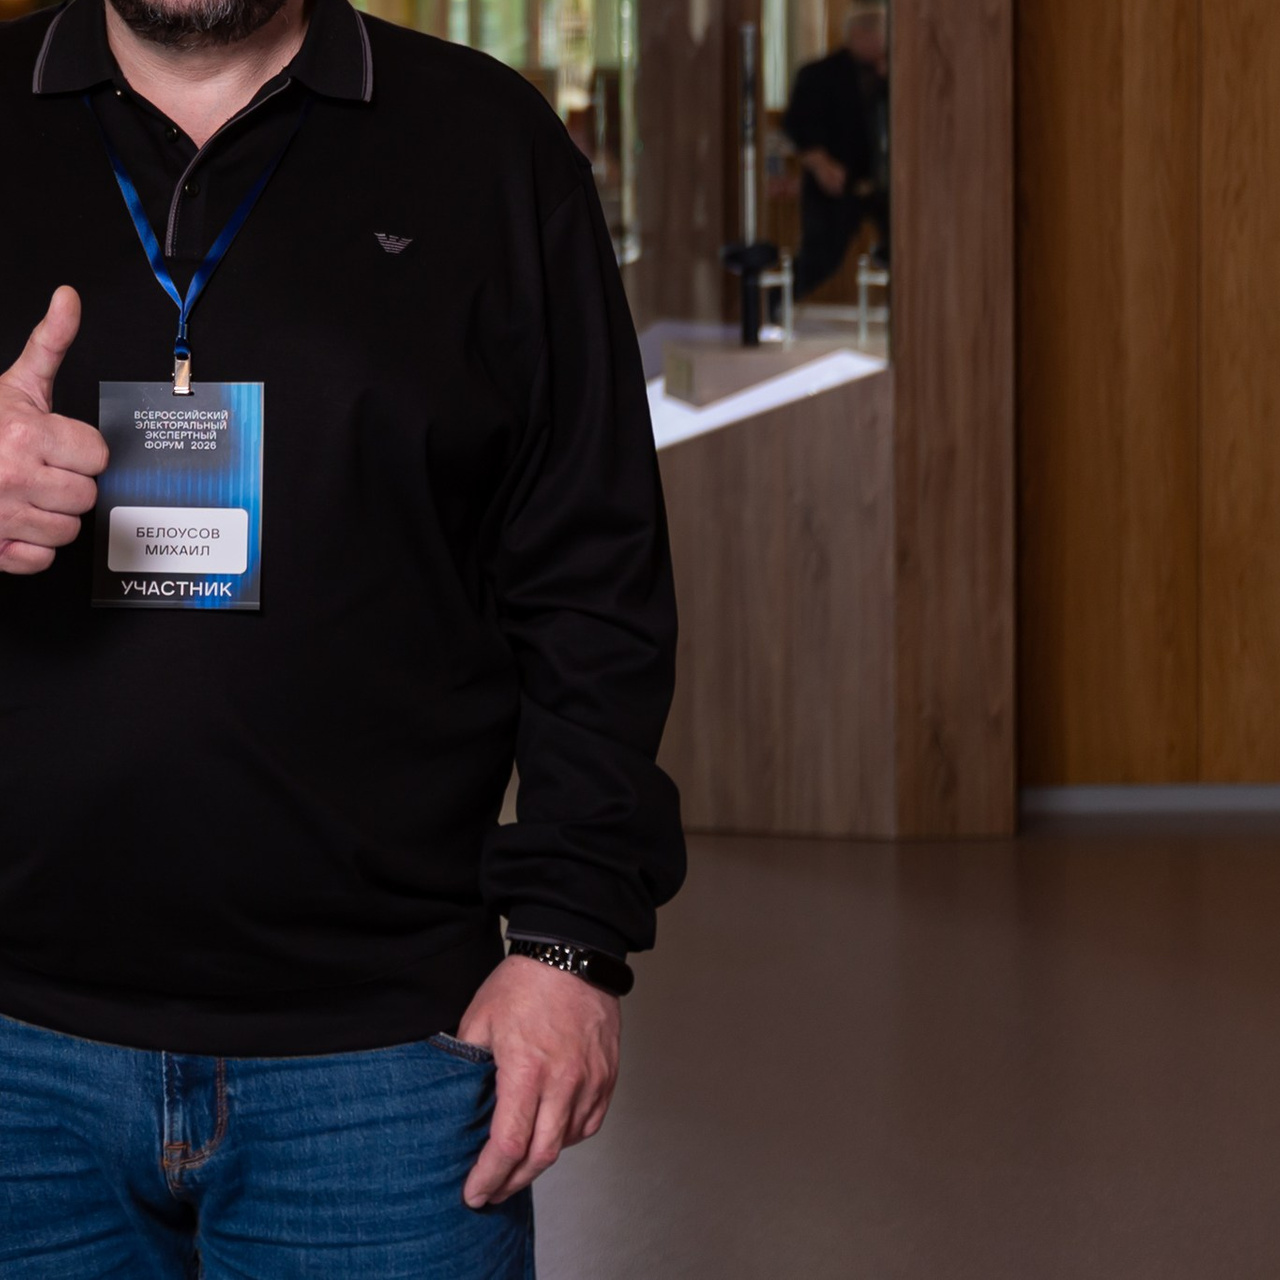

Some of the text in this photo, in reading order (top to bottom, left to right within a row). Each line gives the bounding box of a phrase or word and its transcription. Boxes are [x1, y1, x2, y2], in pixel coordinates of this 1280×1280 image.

[134, 410, 229, 420] ВСЕРОССИЙСКИЙ
[135, 420, 227, 430] ЭЛЕКТОРАЛЬНЫЙ
[145, 430, 217, 440] ЭКСПЕРТНЫЙ
[144, 440, 217, 450] ФОРУМ 2026
[136, 527, 220, 539] БЕЛОУСОВ
[145, 544, 210, 556] МИХАИЛ
[121, 580, 232, 597] УЧАСТНИК
